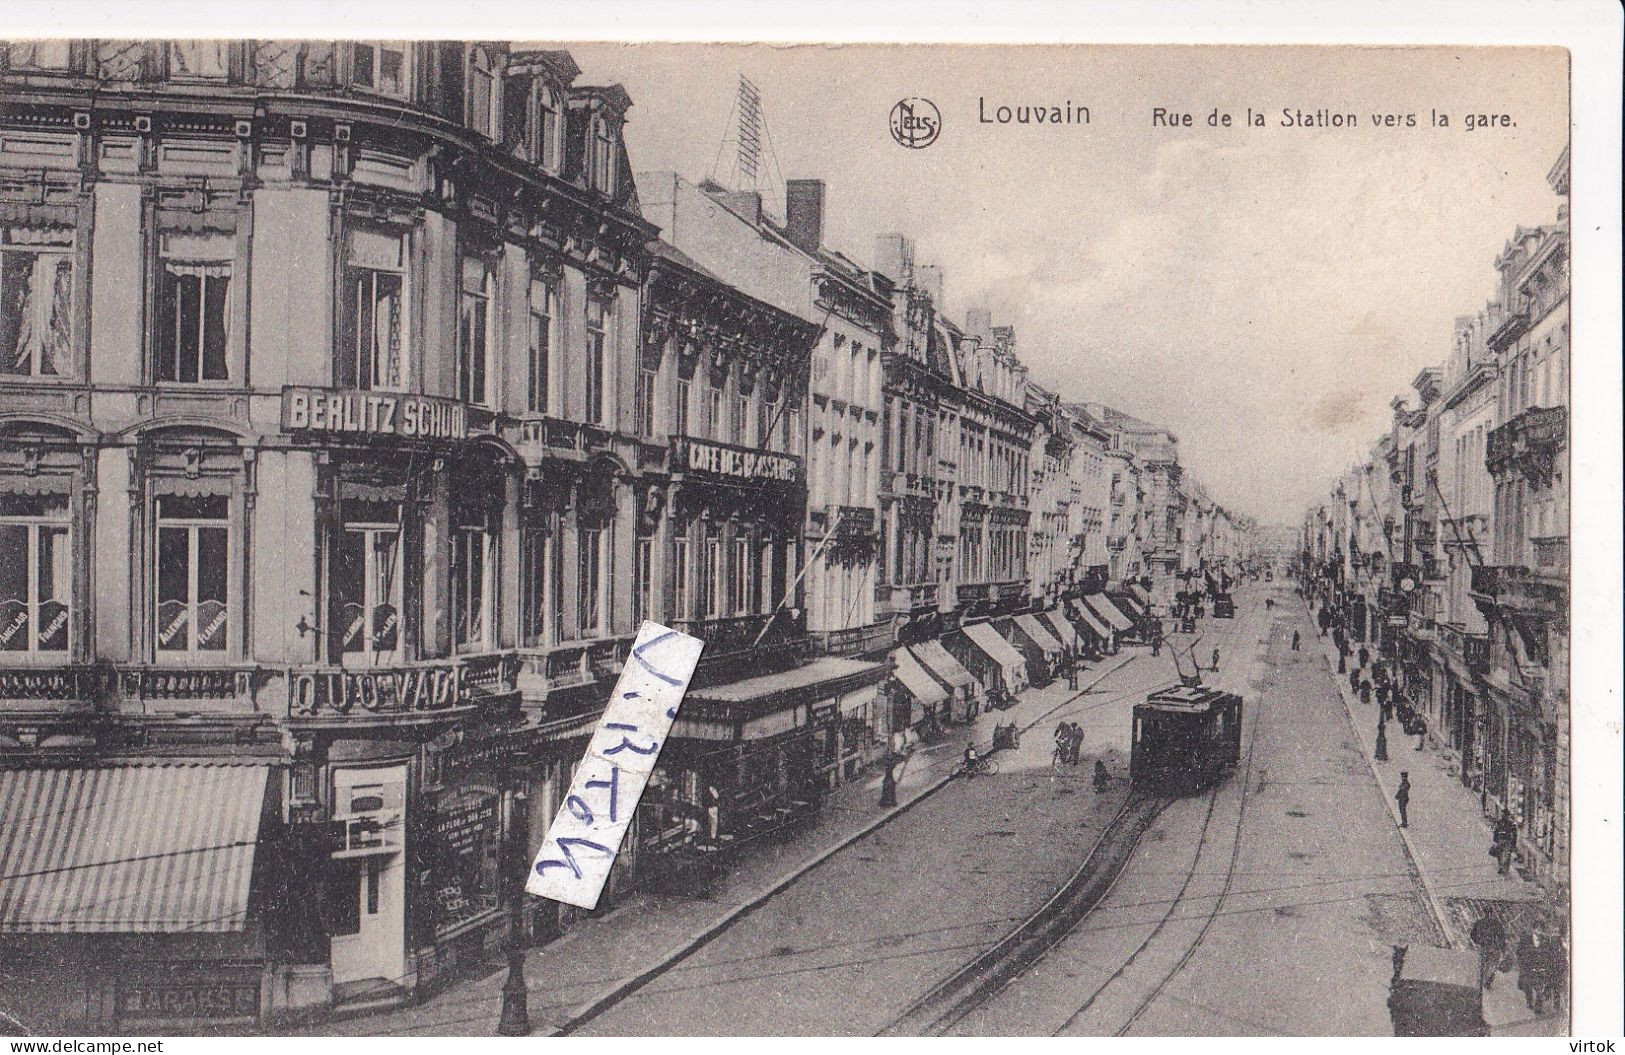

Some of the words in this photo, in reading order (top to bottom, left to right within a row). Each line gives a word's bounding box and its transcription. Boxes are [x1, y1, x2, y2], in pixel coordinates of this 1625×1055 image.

[979, 96, 1090, 124] Louvain
[1152, 107, 1193, 128] Rue
[1207, 107, 1232, 128] de
[1247, 107, 1266, 127] la
[1280, 107, 1357, 128] Station
[1371, 113, 1417, 128] vers
[1432, 108, 1449, 127] la
[1464, 114, 1517, 132] gare.
[290, 392, 398, 434] BERLITZ
[297, 673, 378, 714] QUO
